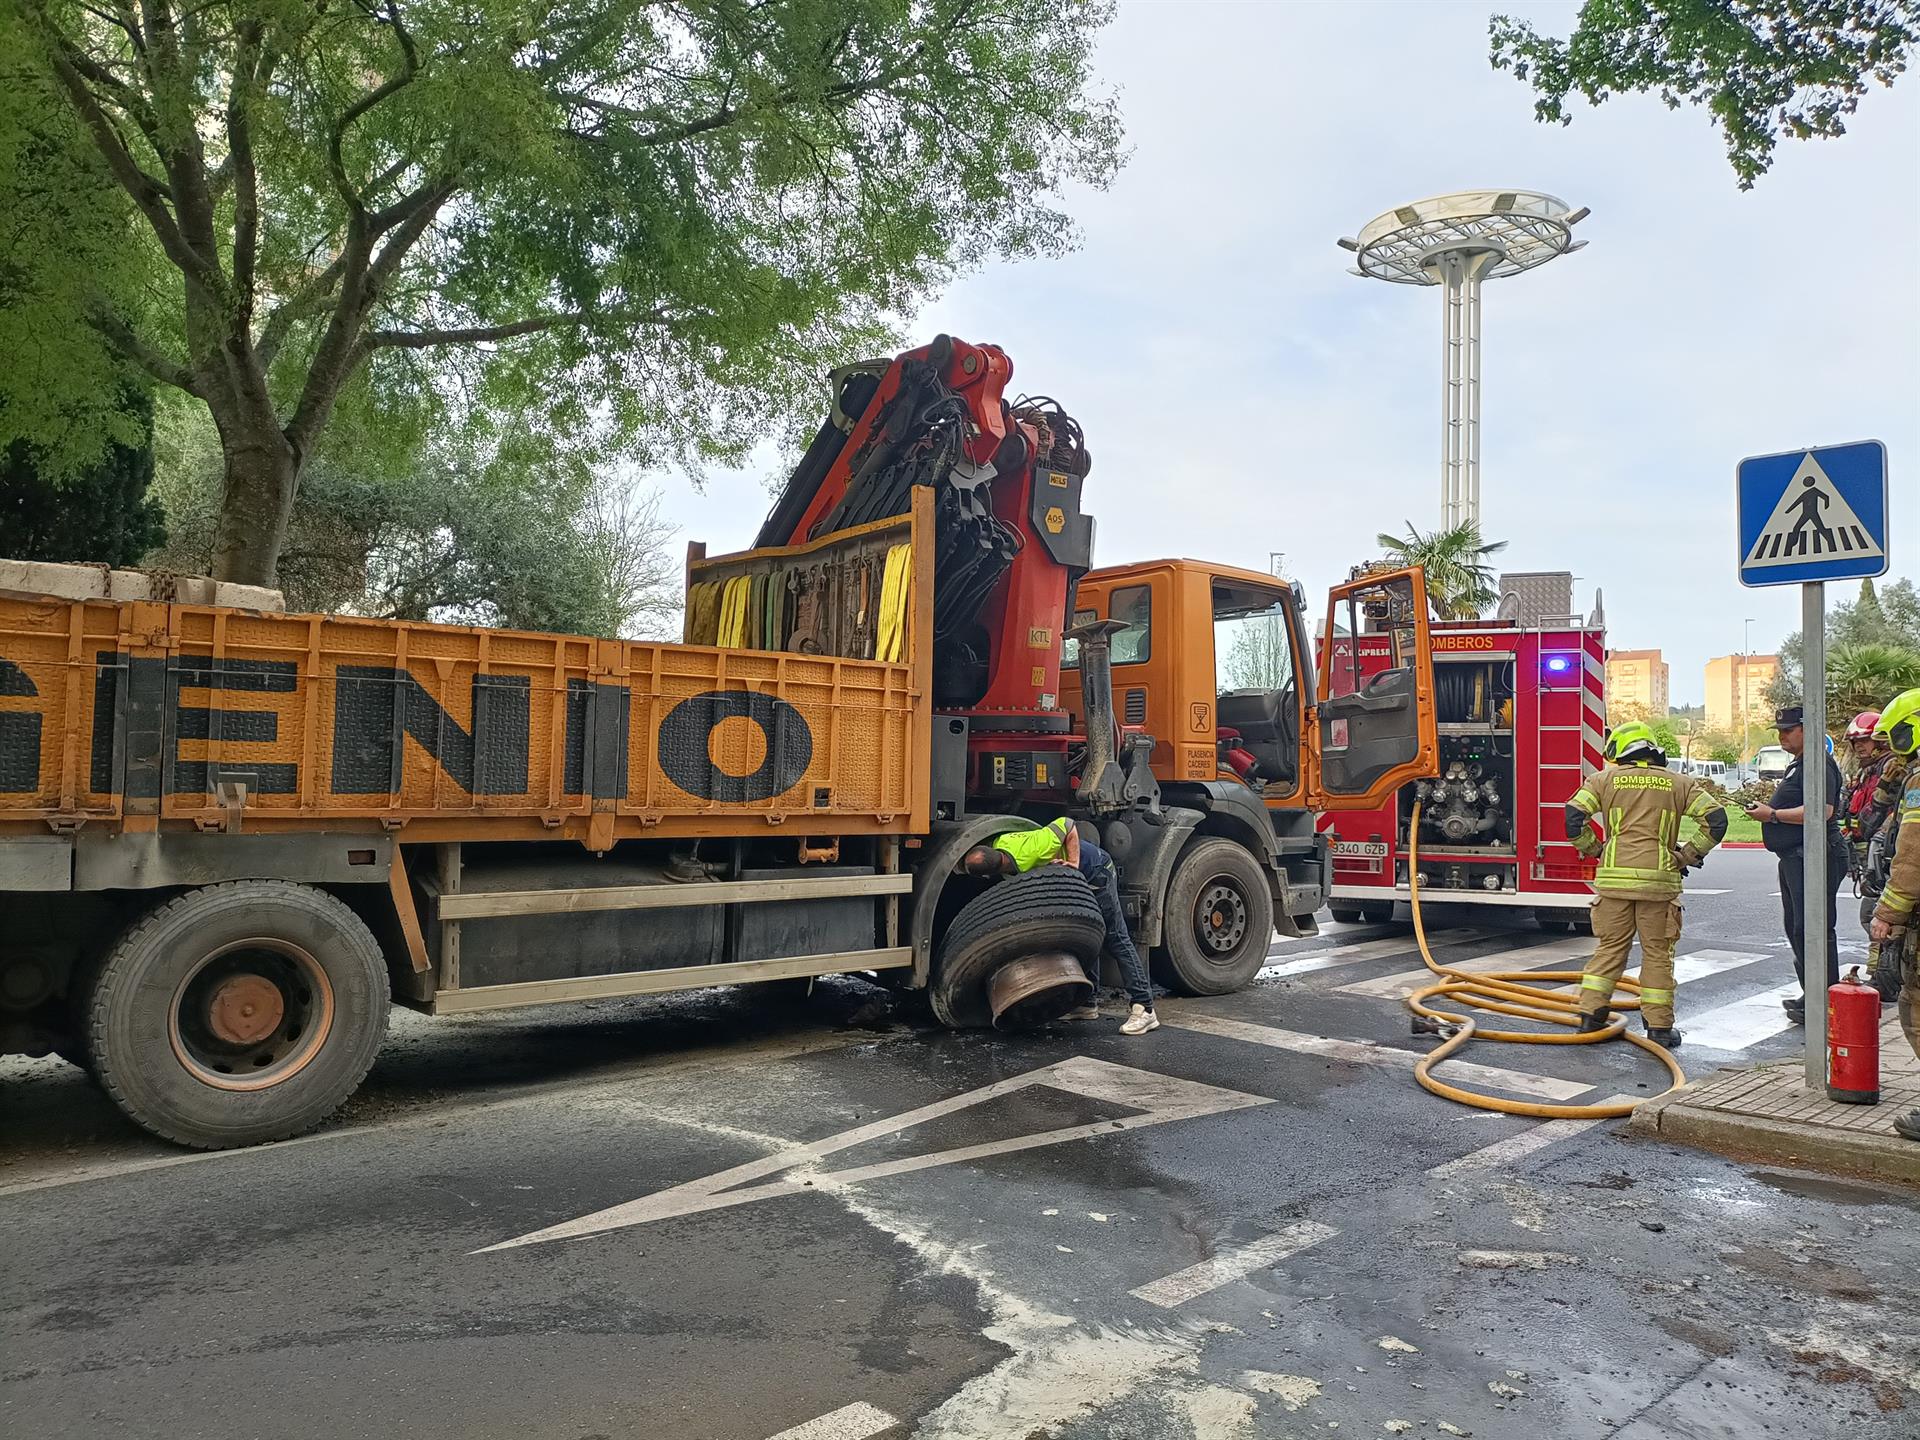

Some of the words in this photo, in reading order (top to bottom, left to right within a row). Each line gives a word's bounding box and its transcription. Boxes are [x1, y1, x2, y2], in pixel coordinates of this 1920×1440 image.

[1047, 514, 1063, 523] AOS
[1030, 630, 1050, 643] KTL
[1431, 636, 1493, 650] MBEROS
[0, 650, 813, 802] ENIO
[1613, 775, 1673, 787] BOMBEROS
[1332, 843, 1359, 854] 9340
[1364, 844, 1386, 855] GZB
